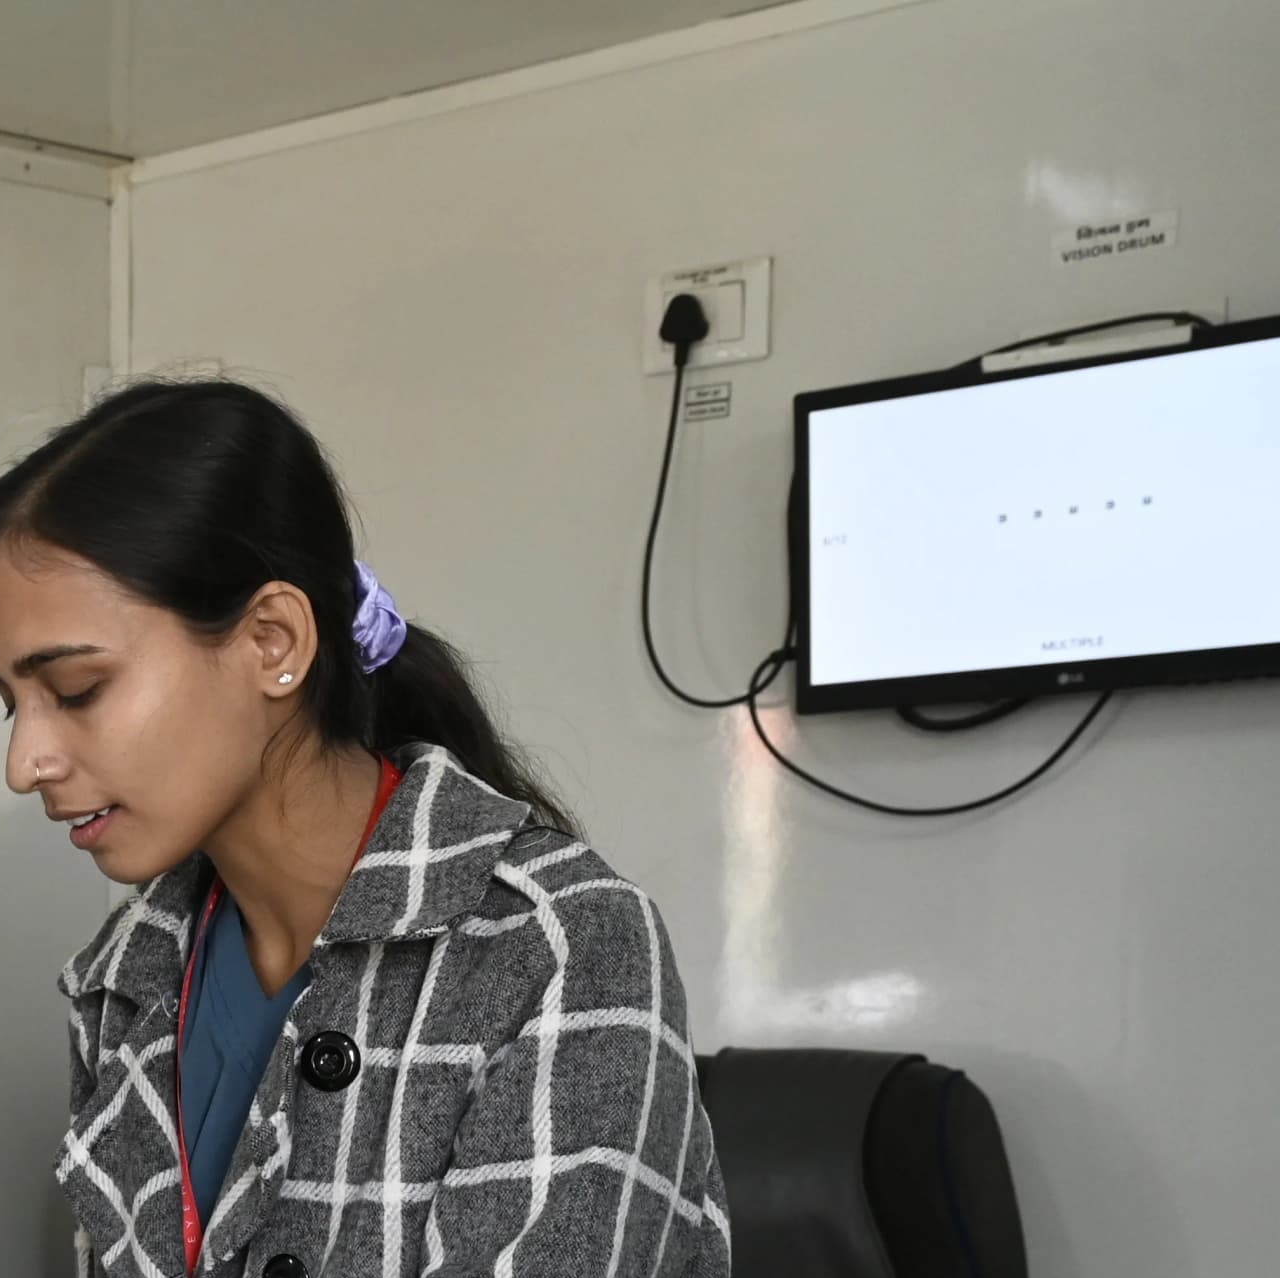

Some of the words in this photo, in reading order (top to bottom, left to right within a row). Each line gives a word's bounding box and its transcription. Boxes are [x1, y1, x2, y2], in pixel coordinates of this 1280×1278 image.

[1061, 244, 1113, 262] VISION
[1117, 233, 1165, 252] DRUM
[1041, 635, 1104, 651] MULTIPLE
